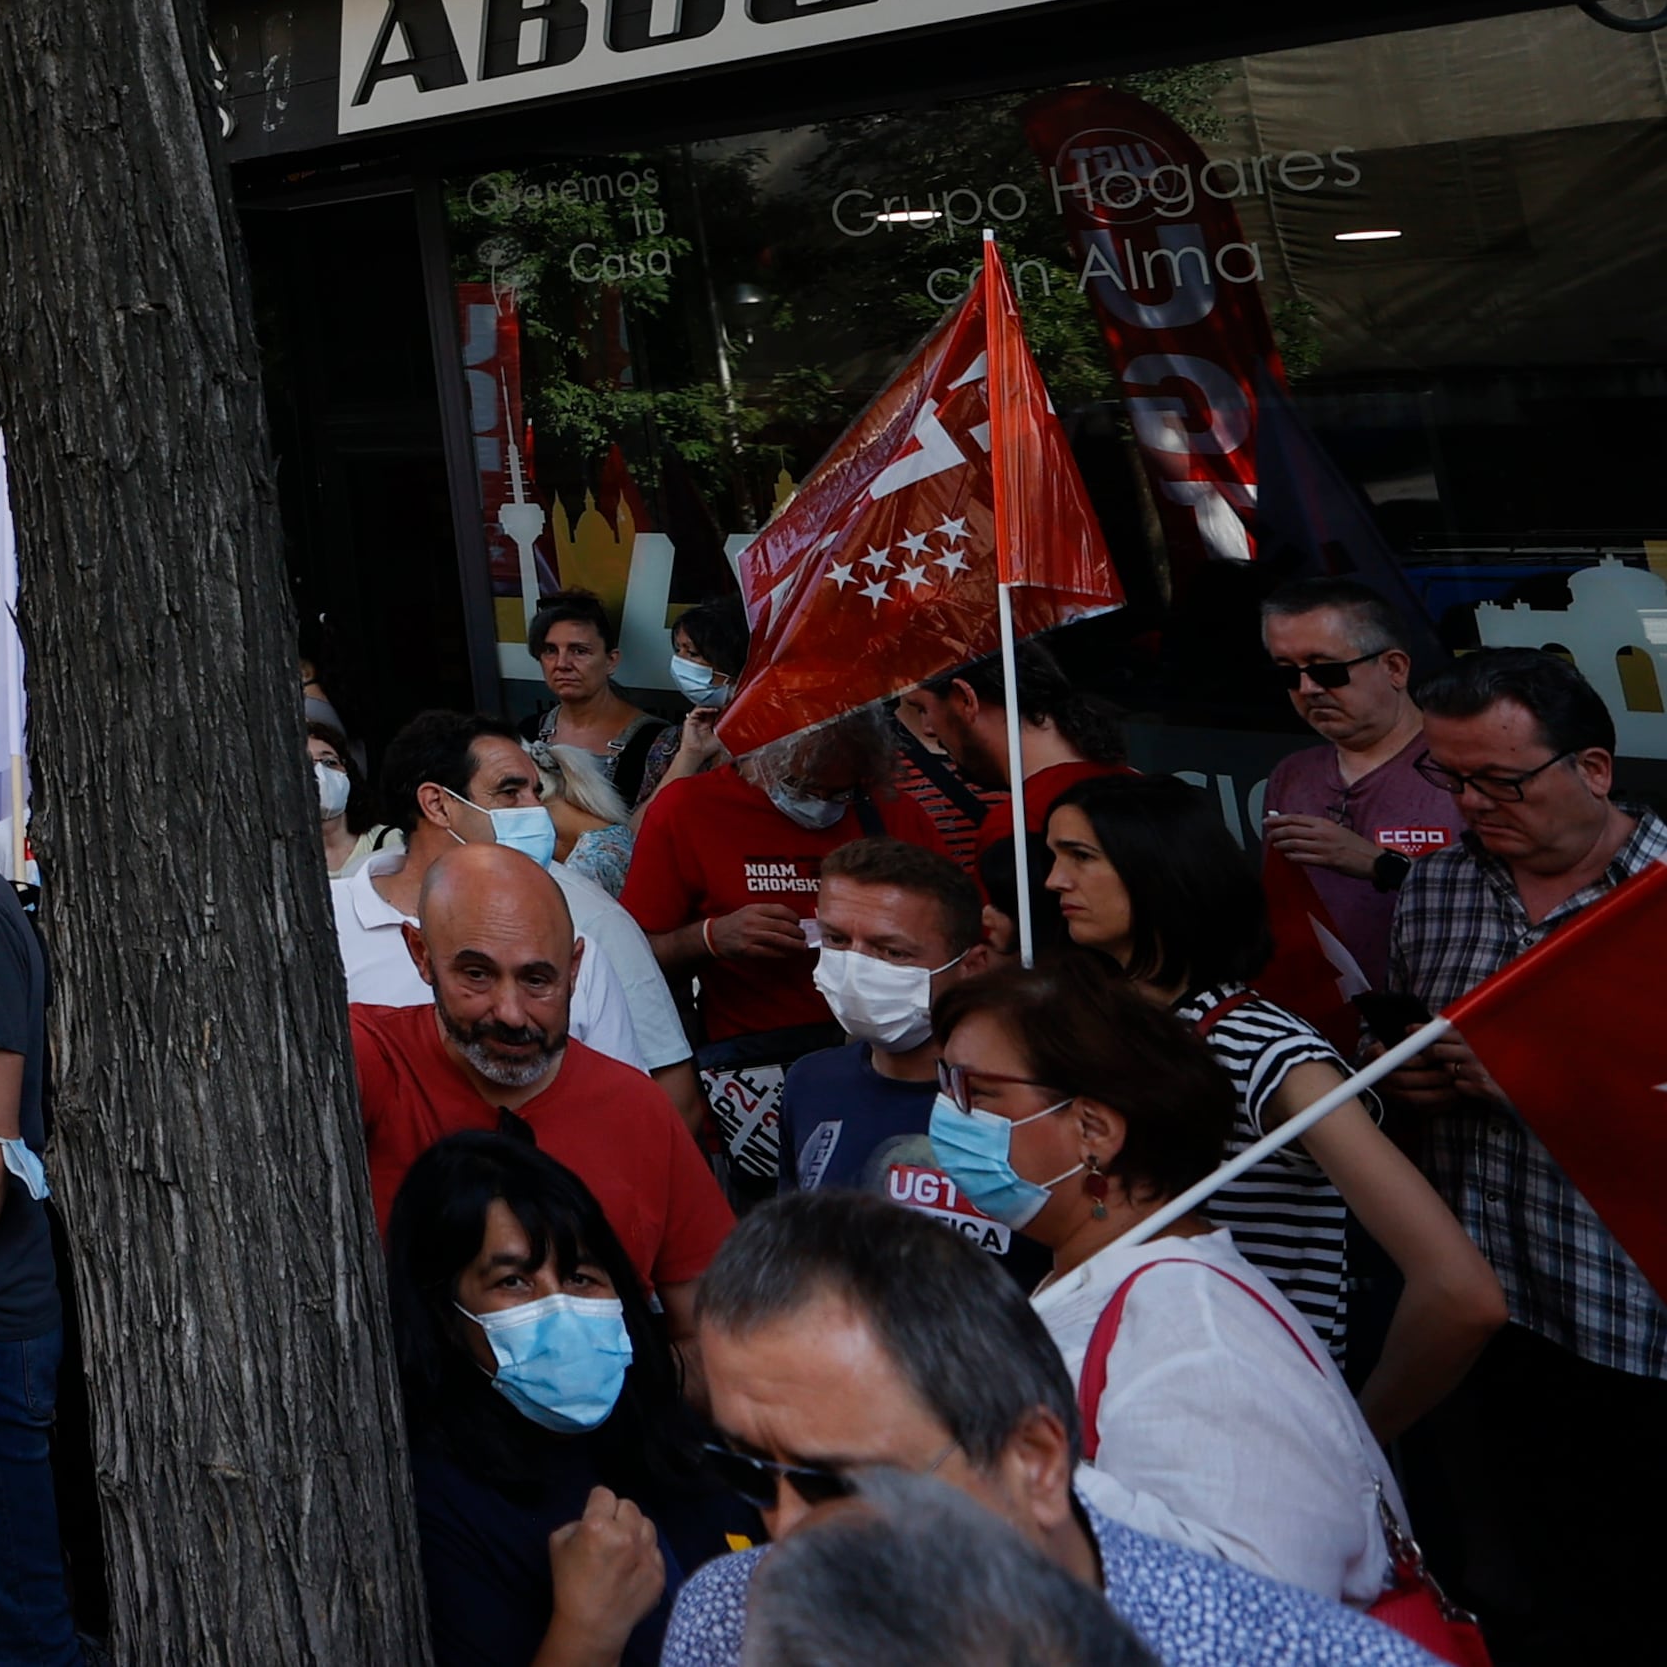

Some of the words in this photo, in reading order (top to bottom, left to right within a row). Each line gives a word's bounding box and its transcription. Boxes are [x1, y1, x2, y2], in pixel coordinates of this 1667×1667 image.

[468, 168, 660, 216] Queremos
[831, 182, 1028, 239] Grupo
[1050, 145, 1362, 219] Hogares
[630, 203, 666, 237] tu
[569, 242, 675, 284] Casa
[1077, 239, 1265, 295] Alma
[1378, 830, 1445, 844] CCOO
[744, 863, 798, 877] NOAM
[746, 877, 822, 892] CHOMSK
[890, 1169, 959, 1209] UGT
